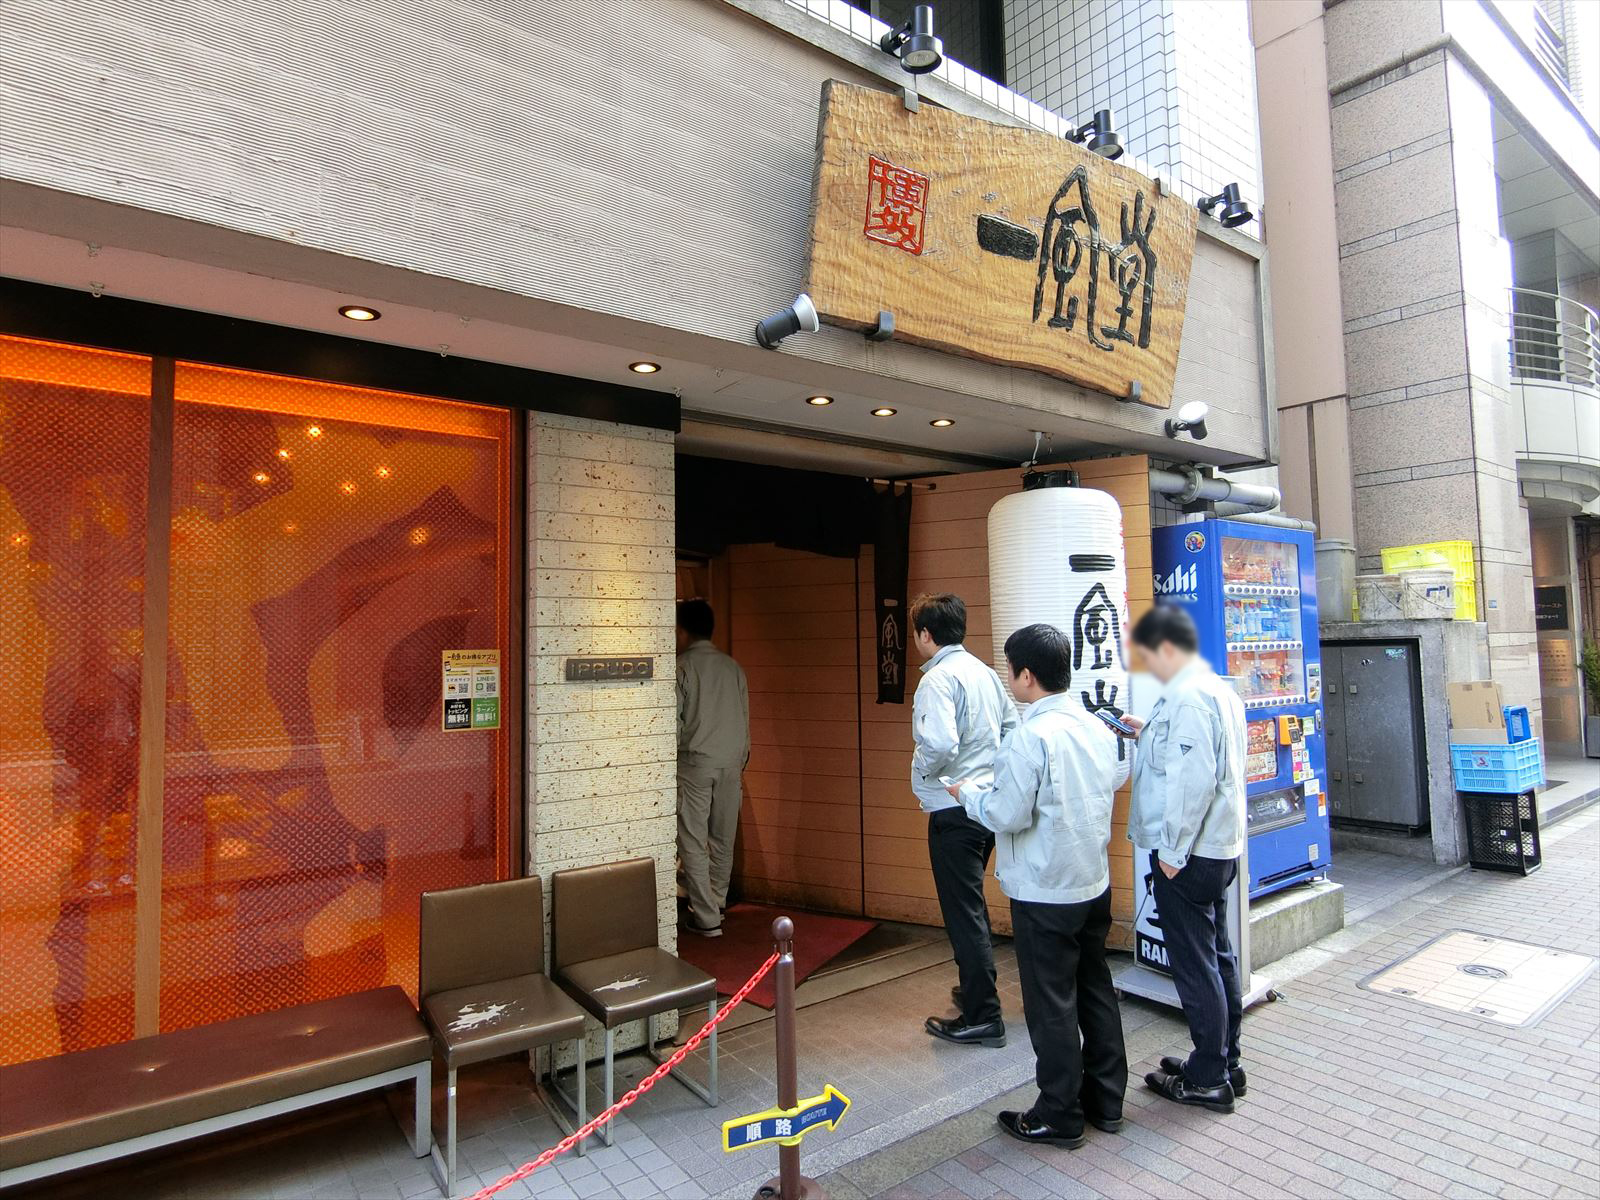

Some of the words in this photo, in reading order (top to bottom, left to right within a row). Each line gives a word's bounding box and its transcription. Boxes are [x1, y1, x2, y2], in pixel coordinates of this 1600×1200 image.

[1153, 562, 1198, 595] sahi
[882, 598, 904, 685] 一風堂
[570, 661, 650, 677] IPPUDO
[1141, 939, 1171, 967] RAM
